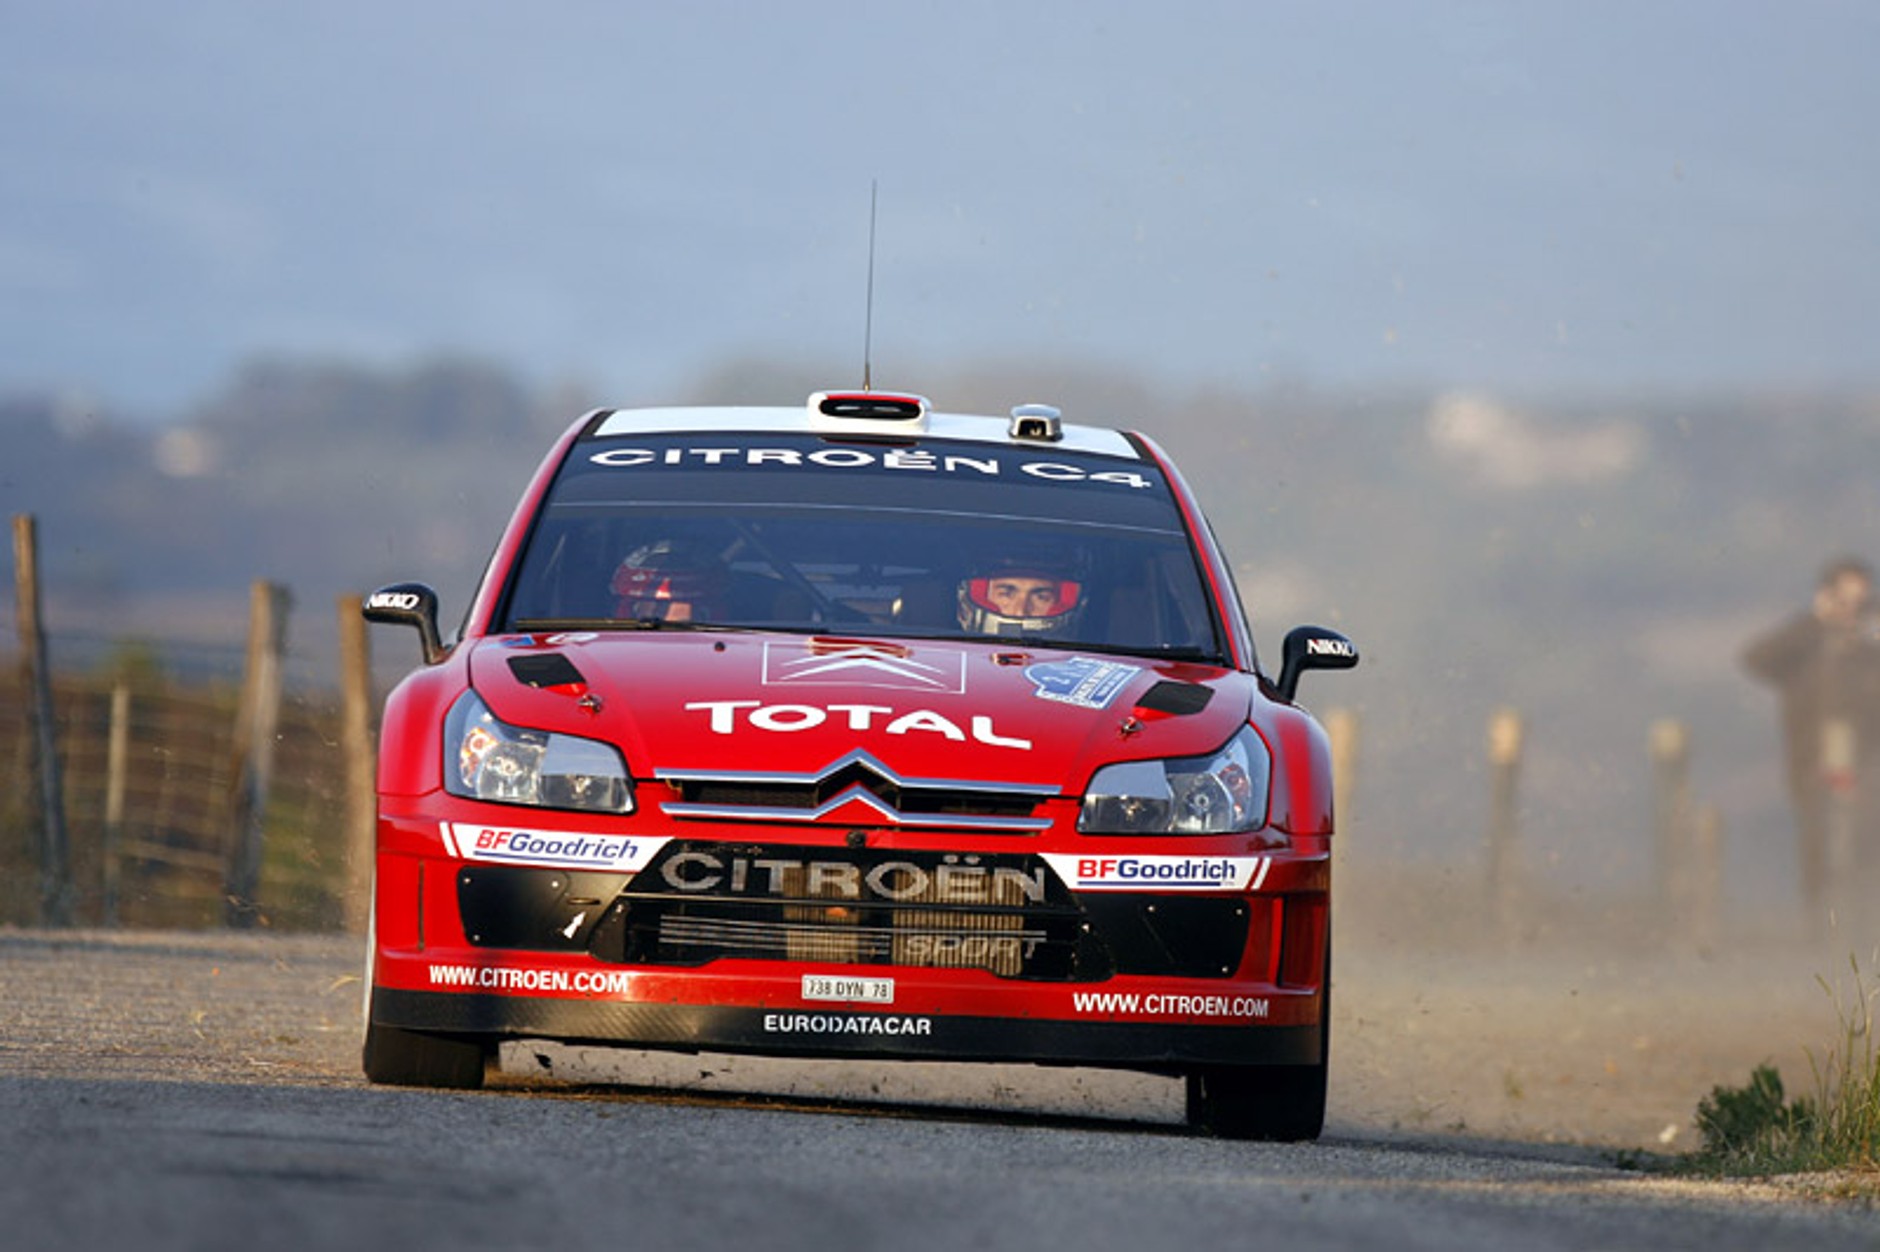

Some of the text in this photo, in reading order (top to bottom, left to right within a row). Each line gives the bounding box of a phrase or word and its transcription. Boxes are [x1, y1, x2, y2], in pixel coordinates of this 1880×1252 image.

[589, 448, 1152, 488] CITROËN C4
[685, 700, 1032, 750] TOTAL
[474, 828, 638, 859] BFGoodrich
[660, 852, 1045, 902] CITROËN
[1077, 858, 1236, 880] BFGoodrich
[907, 934, 1042, 960] SPORT
[429, 964, 628, 994] WWW.CITROEN.COM
[809, 979, 888, 998] 738 DYN 78
[1072, 992, 1269, 1018] WWW.CITROEN.COM
[763, 1014, 932, 1036] EURODATACAR
